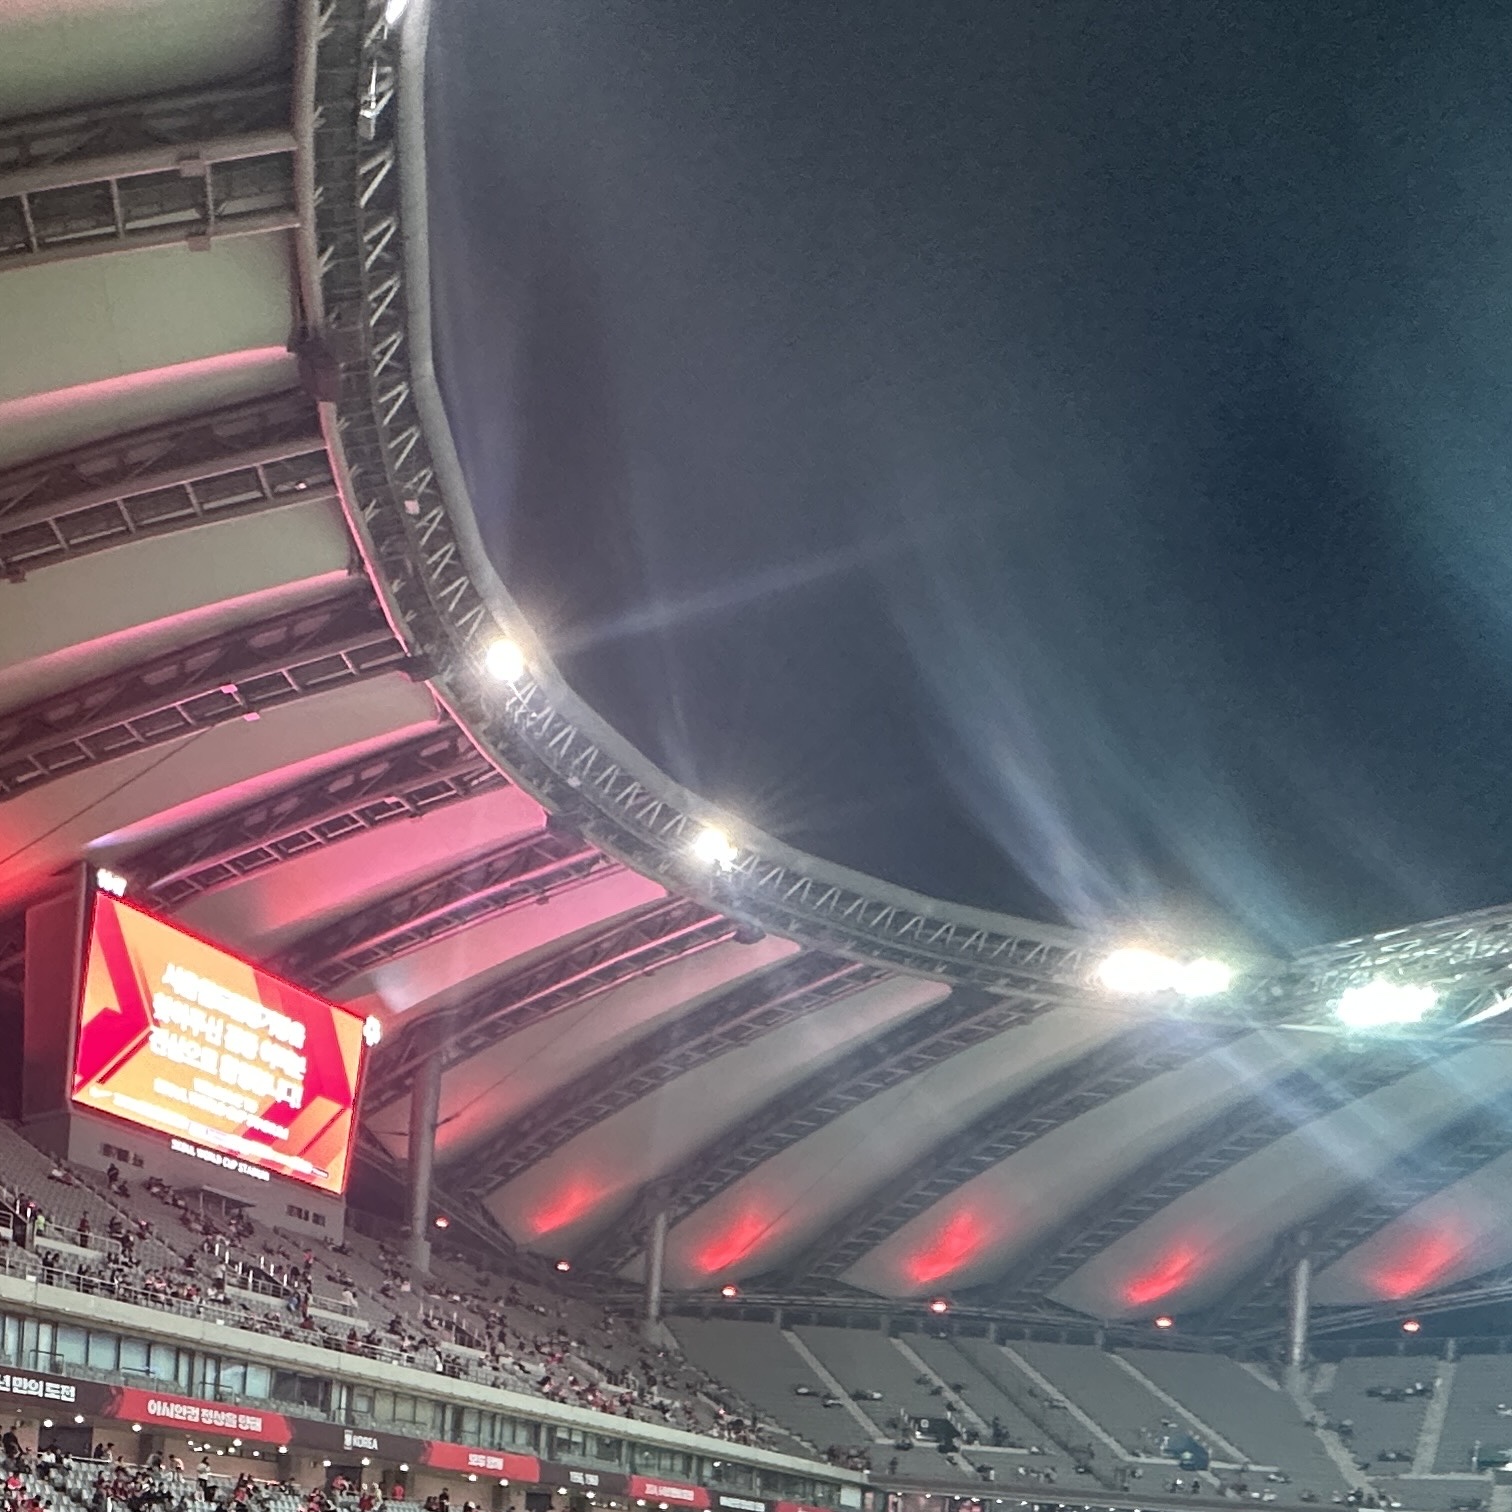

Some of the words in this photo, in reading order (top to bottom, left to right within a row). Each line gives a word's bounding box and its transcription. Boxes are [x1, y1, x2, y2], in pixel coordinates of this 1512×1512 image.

[12, 1376, 44, 1398] 만의
[44, 1382, 76, 1403] 도전
[353, 1435, 379, 1450] KOREA
